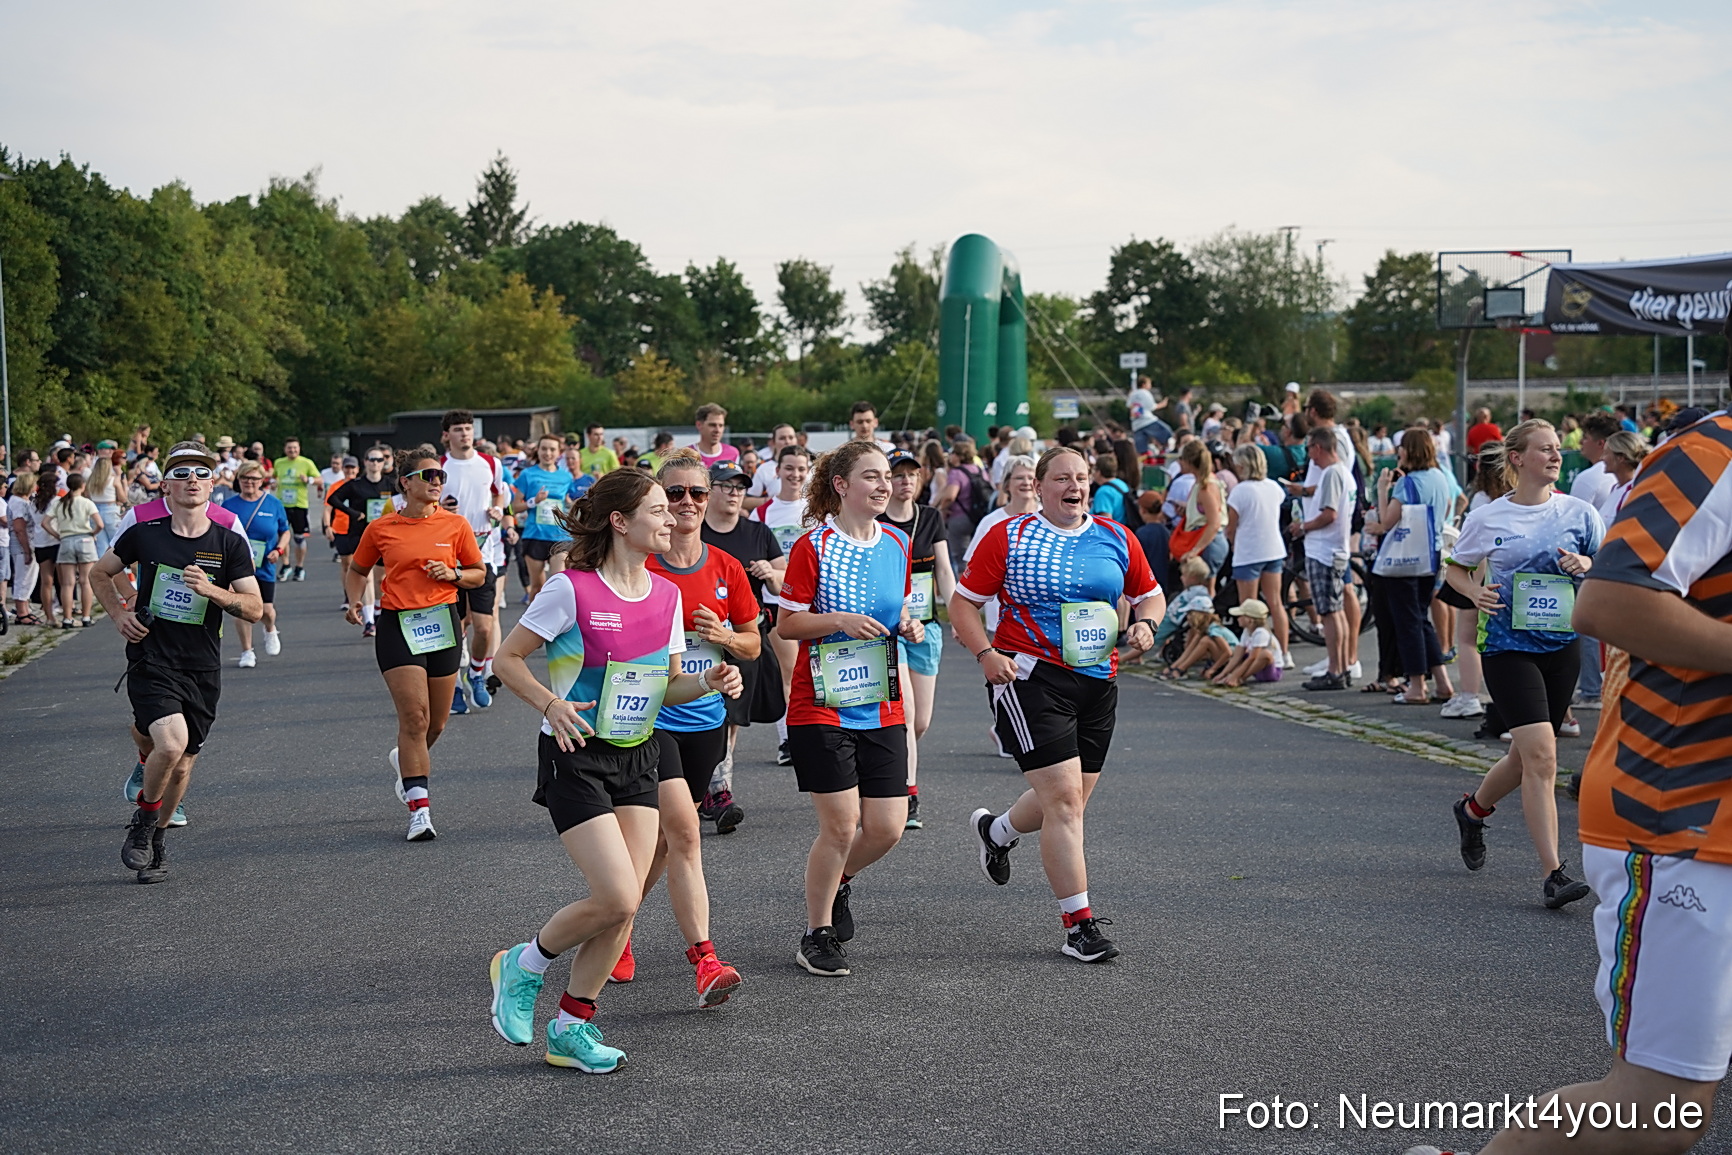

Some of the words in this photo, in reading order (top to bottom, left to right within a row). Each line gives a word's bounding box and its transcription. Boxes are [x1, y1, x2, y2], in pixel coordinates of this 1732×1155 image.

[1629, 285, 1677, 321] Hier
[165, 589, 192, 604] 255
[1528, 597, 1558, 609] 292
[412, 623, 441, 637] 1069
[1075, 628, 1107, 642] 1996
[681, 659, 713, 674] 2010
[838, 665, 869, 682] 2011
[832, 684, 859, 693] Katharina
[859, 680, 881, 688] Weibert
[616, 694, 650, 712] 1737
[612, 713, 626, 722] Katja
